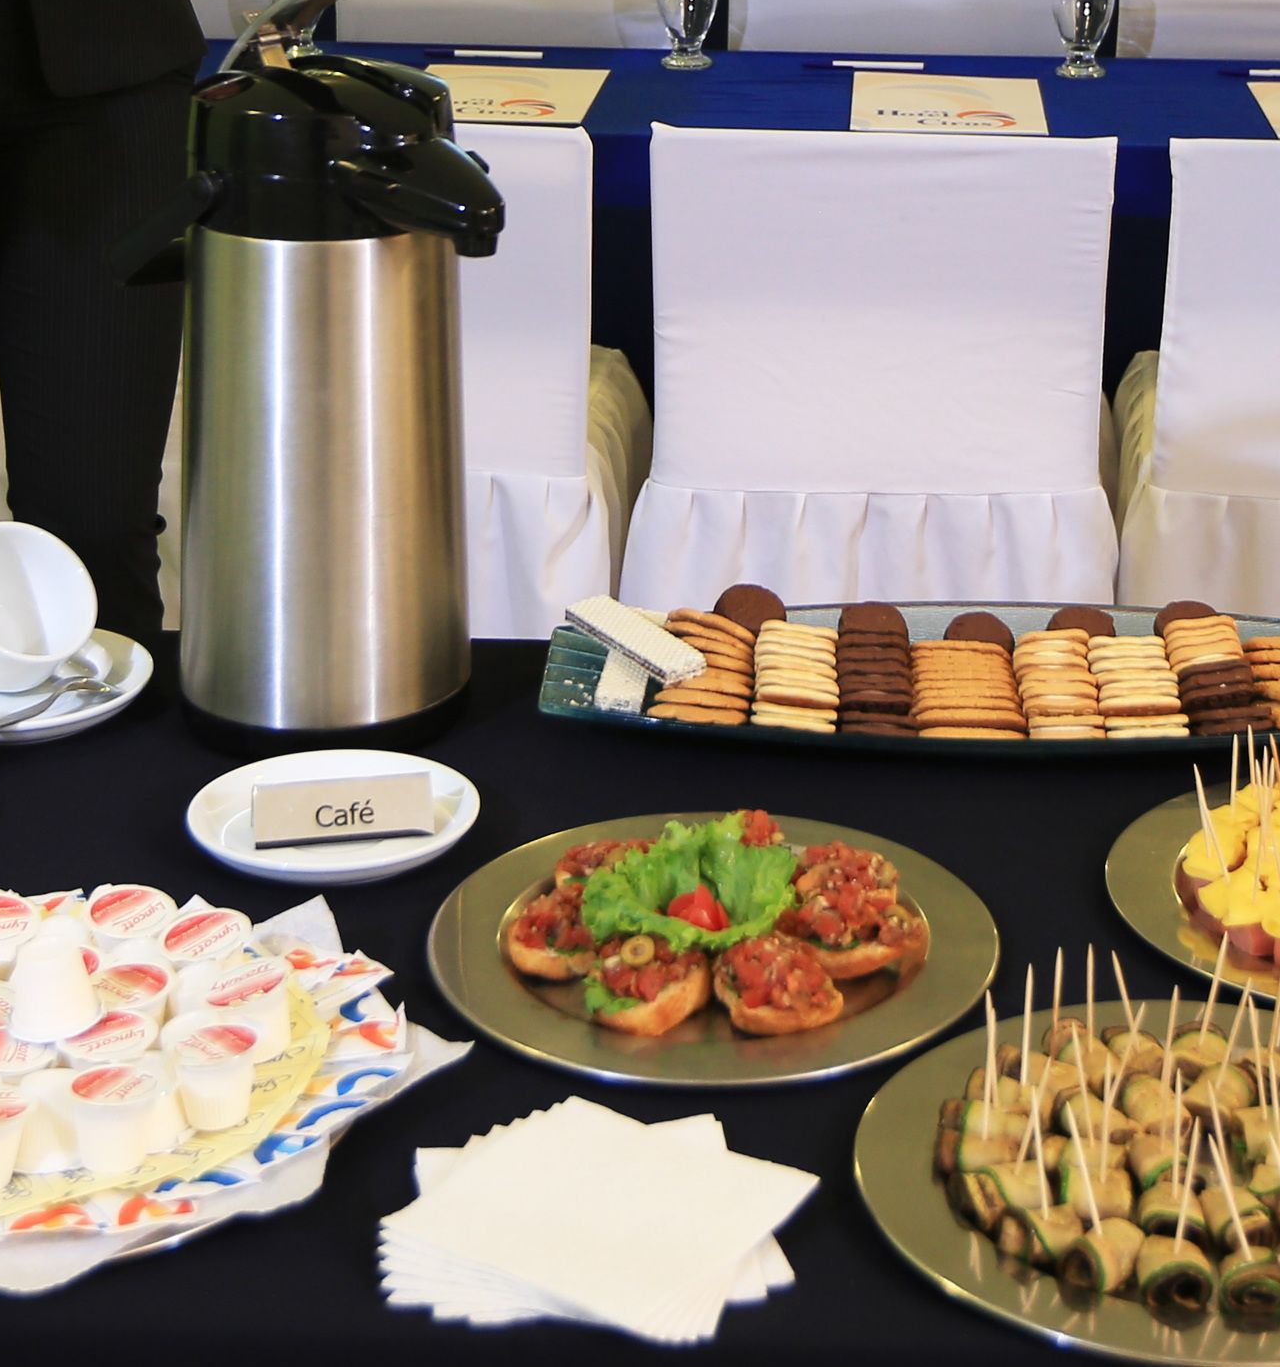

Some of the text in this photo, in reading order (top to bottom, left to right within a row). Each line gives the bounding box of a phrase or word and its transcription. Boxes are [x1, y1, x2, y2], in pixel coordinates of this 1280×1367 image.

[314, 799, 375, 828] Café
[120, 900, 167, 933] Lyncott
[191, 920, 241, 957] Lyncott
[87, 1028, 146, 1052] Lyncott
